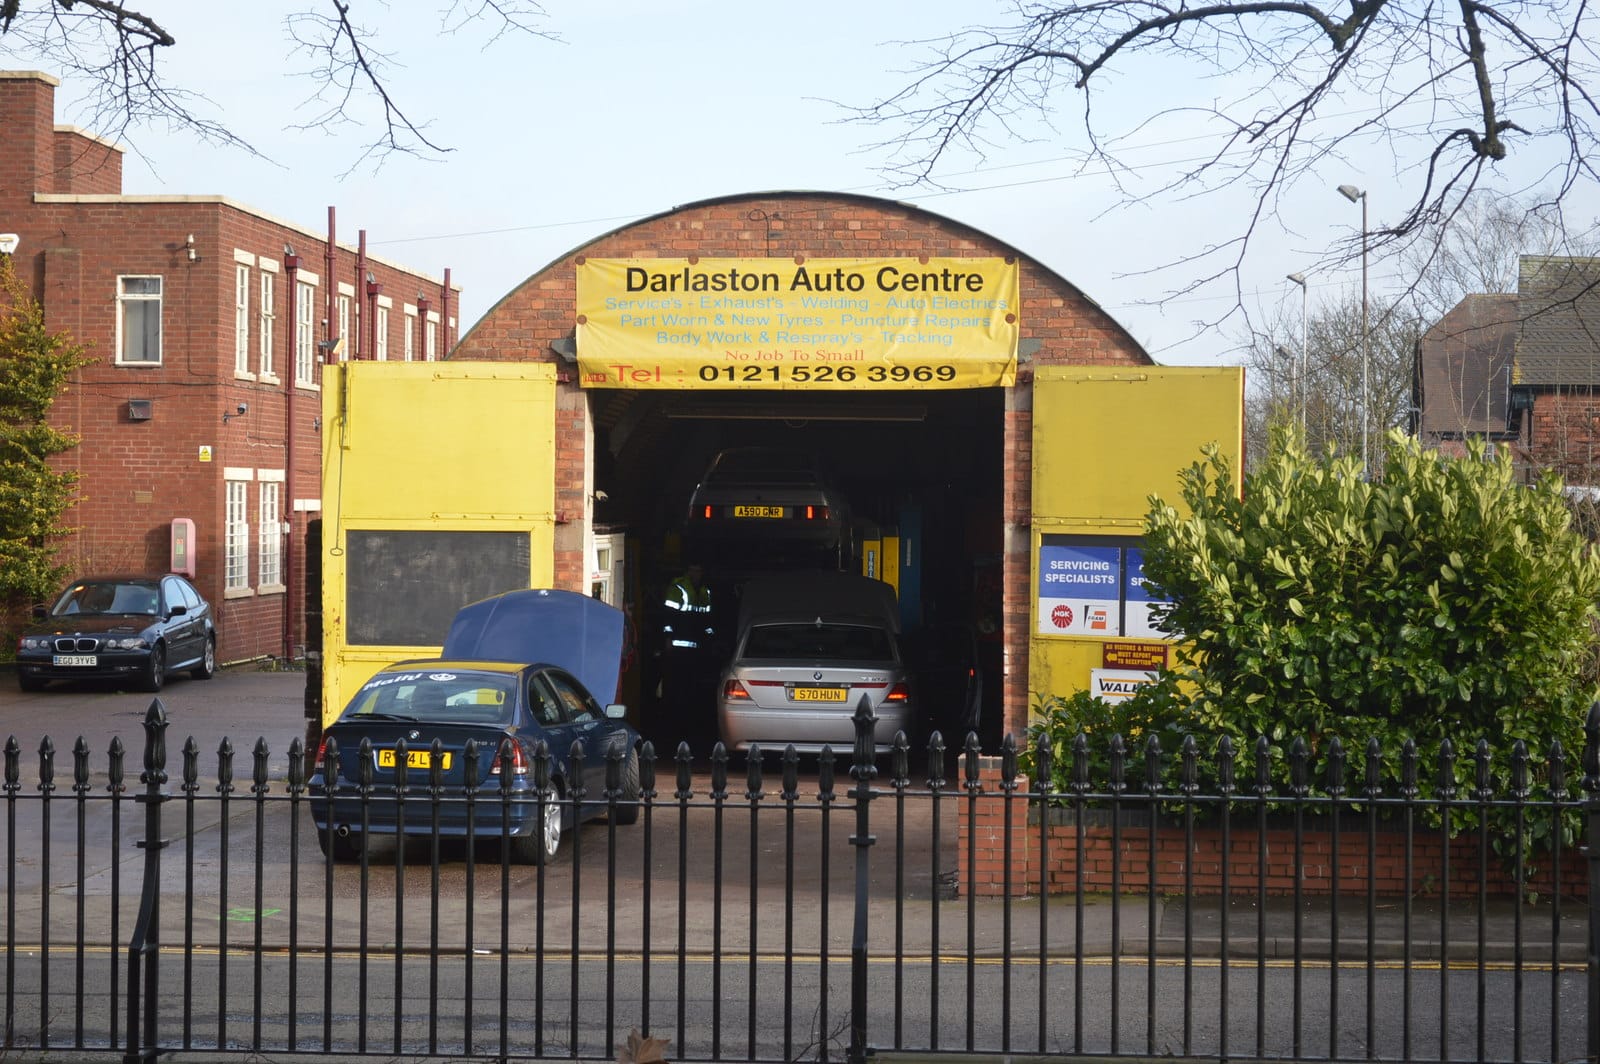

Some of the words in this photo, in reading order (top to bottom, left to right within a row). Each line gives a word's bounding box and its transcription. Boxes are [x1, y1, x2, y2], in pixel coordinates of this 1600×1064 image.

[626, 267, 779, 292] Darlaston
[790, 266, 865, 292] Auto
[876, 266, 984, 292] Centre
[605, 297, 683, 310] Service's
[700, 296, 784, 309] Exhaust's
[801, 296, 869, 311] Welding
[886, 296, 926, 310] Auto
[932, 296, 1008, 310] Electrics
[621, 314, 656, 327] Part
[662, 314, 707, 327] Worn
[714, 314, 725, 326] &
[732, 314, 770, 326] New
[776, 314, 824, 328] Tyres
[841, 314, 920, 327] Puncture
[925, 314, 991, 329] Repairs
[657, 331, 701, 346] Body
[707, 331, 752, 343] Work
[759, 331, 770, 343] &
[777, 331, 863, 346] Respray's
[881, 331, 953, 346] Tracking
[725, 350, 749, 361] No
[754, 350, 784, 361] Job
[790, 350, 809, 361] To
[815, 350, 864, 361] Small
[609, 365, 660, 382] Tel
[699, 365, 780, 382] 0121
[791, 365, 857, 382] 526
[867, 365, 956, 382] 3969
[1050, 560, 1110, 571] SERVICING
[1045, 573, 1115, 584] SPECIALISTS
